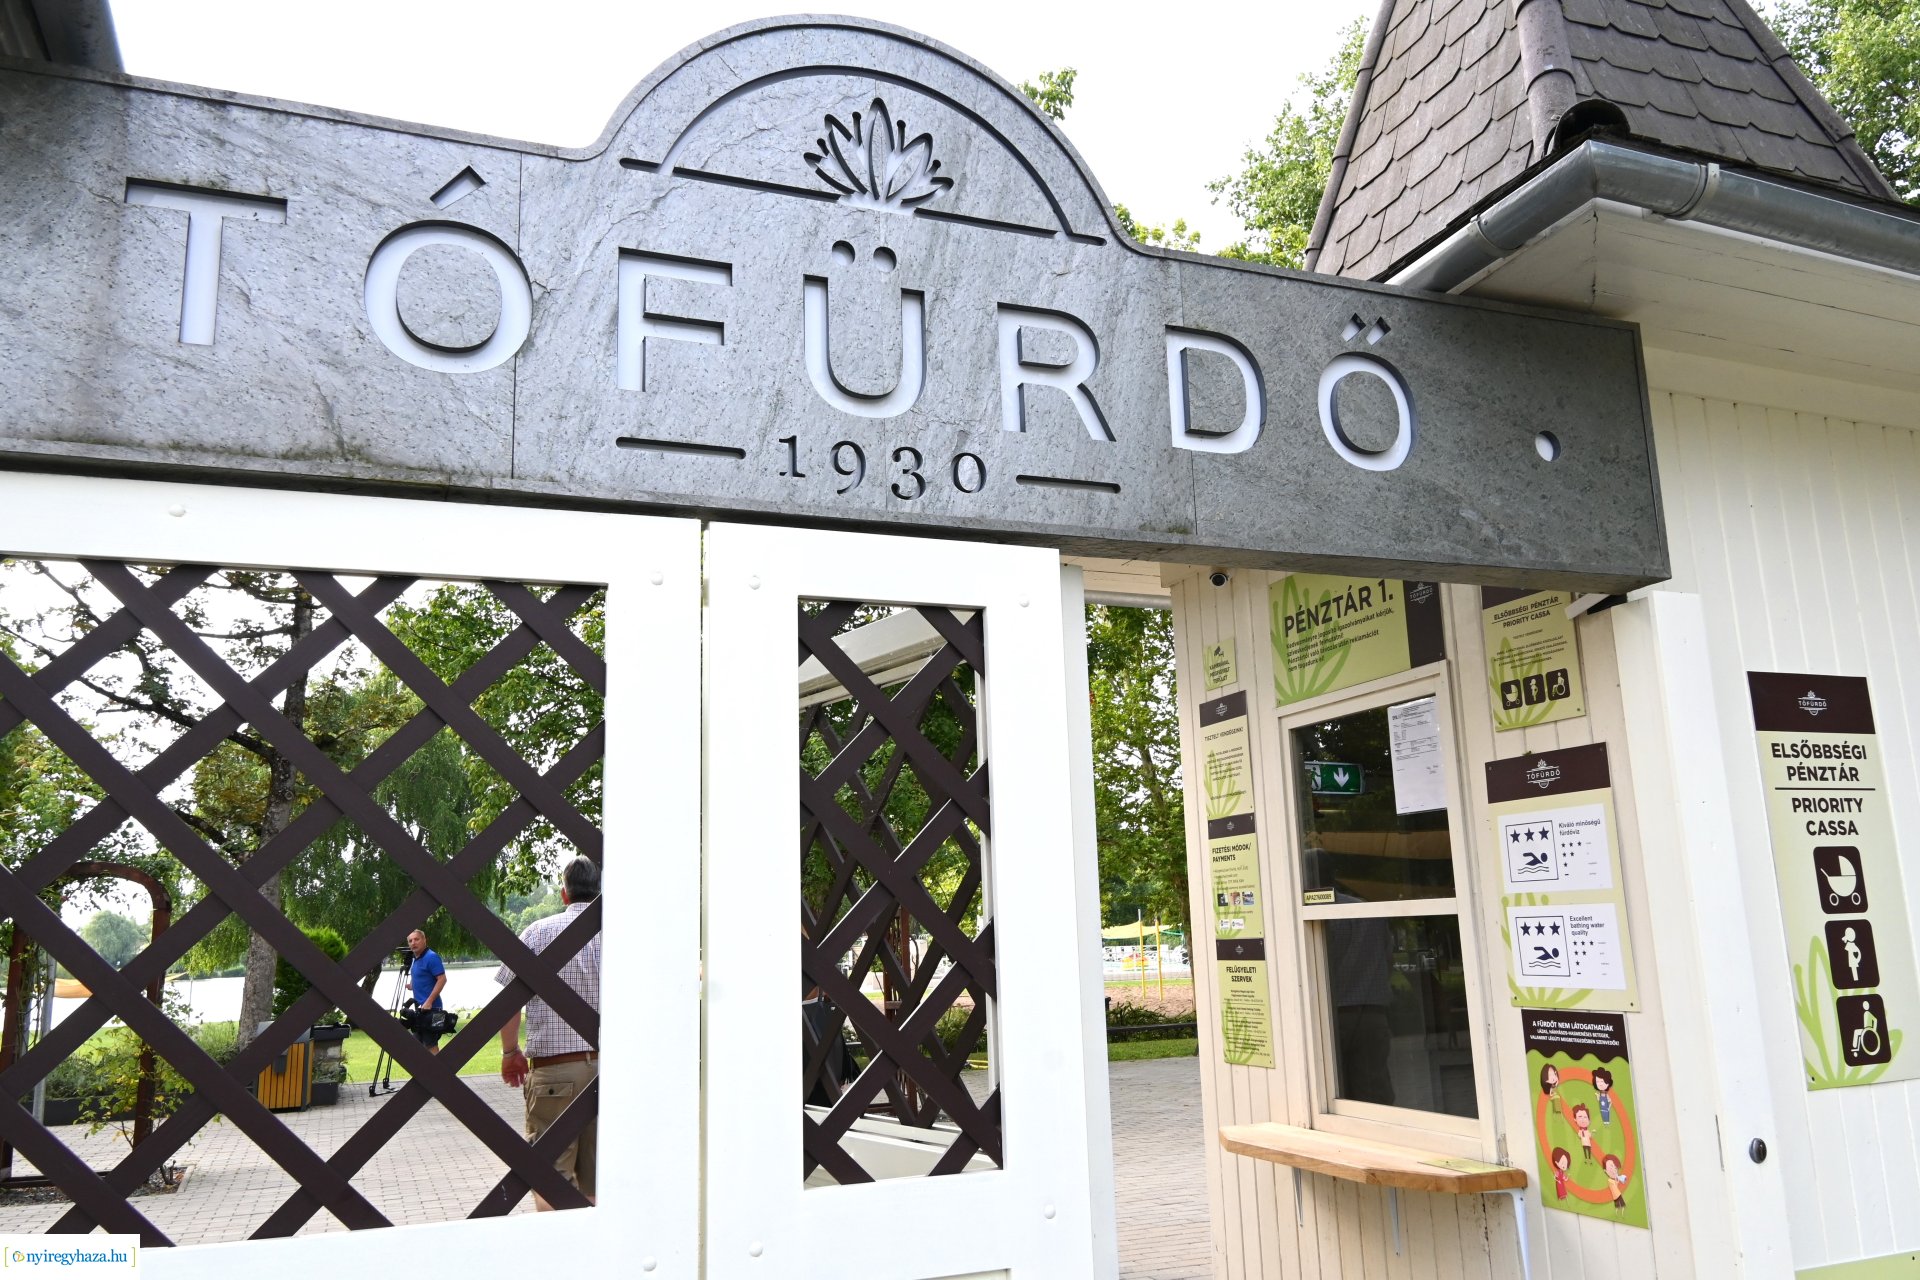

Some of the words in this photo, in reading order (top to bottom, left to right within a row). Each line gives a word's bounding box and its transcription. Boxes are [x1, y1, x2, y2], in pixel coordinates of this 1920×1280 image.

[126, 165, 1419, 472] TÓFÜRDŐ
[778, 435, 986, 500] 1930
[1285, 584, 1372, 637] PÉNZTÁR
[1378, 579, 1393, 602] 1.
[1493, 605, 1529, 621] ELSŐBBSÉGI
[1530, 596, 1559, 609] PÉNZTÁR
[1503, 616, 1529, 628] PRIORITY
[1530, 610, 1551, 621] CASSA
[1771, 739, 1867, 760] ELSŐBBSÉGI
[1526, 769, 1560, 780] TÓFÜRDŐ
[1786, 762, 1860, 782] PÉNZTÁR
[1791, 797, 1863, 813] PRIORITY
[1806, 820, 1859, 836] CASSA
[1212, 844, 1232, 854] FIZETÉSI
[1212, 854, 1236, 863] PAYMENTS
[1570, 922, 1590, 930] bathing
[1231, 975, 1253, 983] SZERVEK
[1537, 1019, 1557, 1028] FÜRDŐT
[1557, 1021, 1570, 1029] NEM
[1570, 1021, 1614, 1032] LÁTOGATHATJÁK
